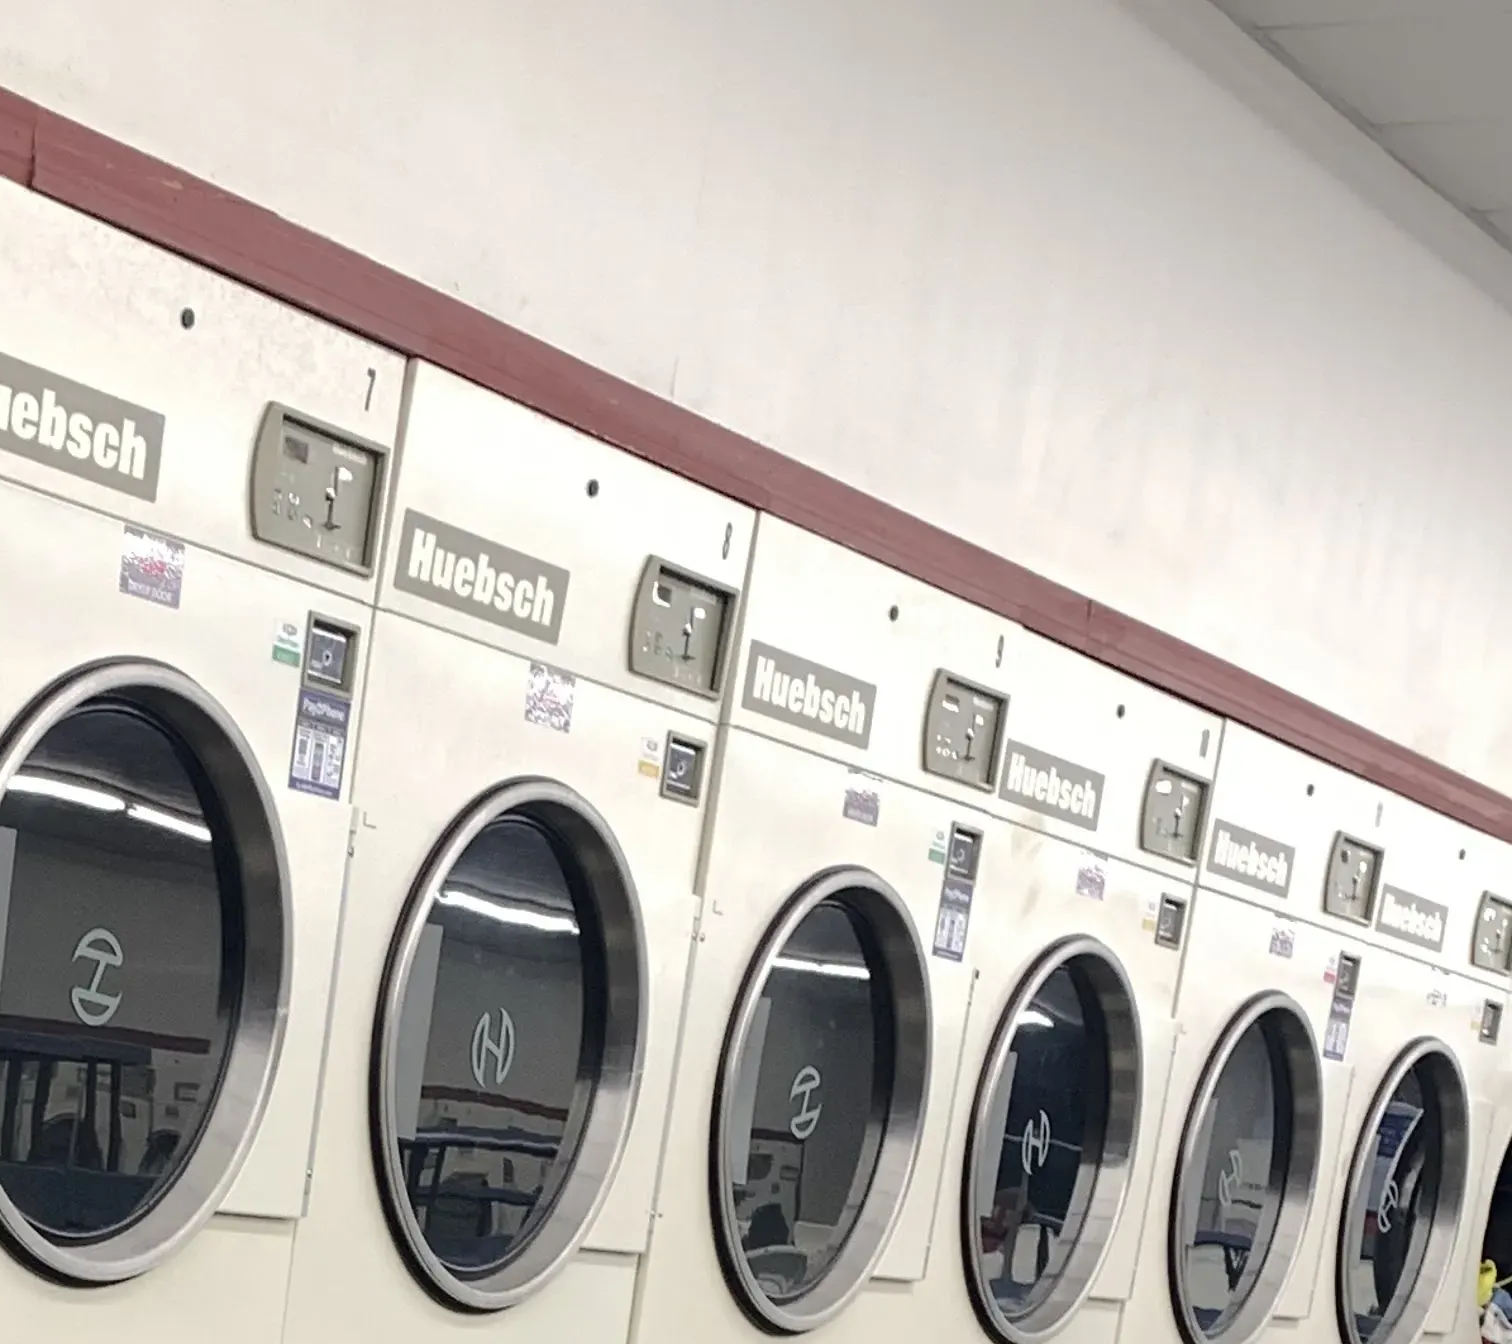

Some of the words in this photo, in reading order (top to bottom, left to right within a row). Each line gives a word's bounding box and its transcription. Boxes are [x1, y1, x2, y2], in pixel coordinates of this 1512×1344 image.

[366, 367, 376, 411] 7
[722, 522, 733, 560] 8
[408, 527, 554, 627] Huebsch
[752, 655, 866, 735] Huebsch
[1006, 752, 1096, 819] Huebsch
[1214, 829, 1288, 888] Huebsch
